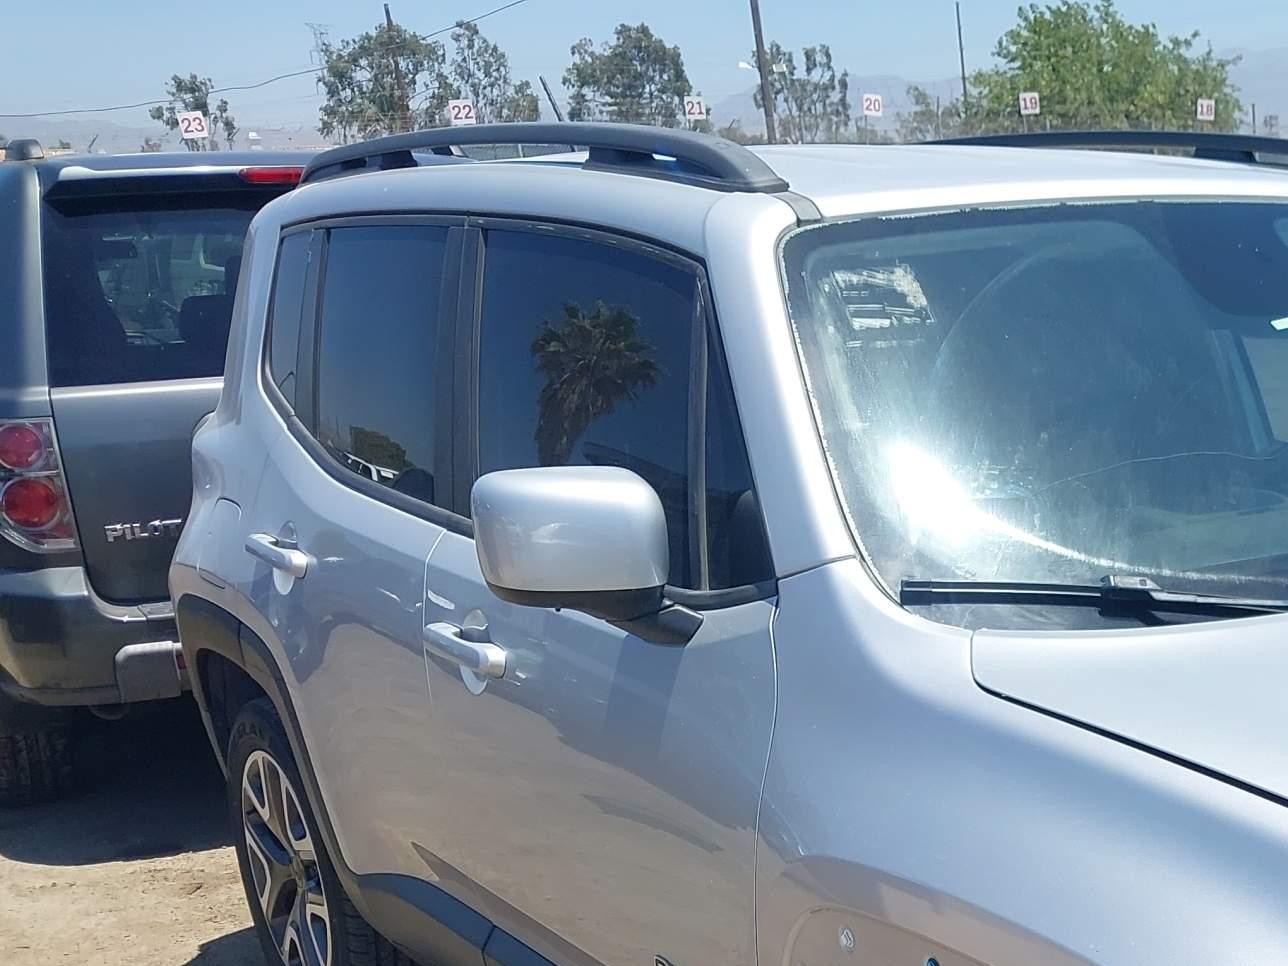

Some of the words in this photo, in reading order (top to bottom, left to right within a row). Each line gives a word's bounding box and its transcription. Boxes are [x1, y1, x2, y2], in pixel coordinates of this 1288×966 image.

[686, 100, 705, 115] 21
[864, 97, 881, 113] 20
[1021, 96, 1038, 110] 19
[1199, 103, 1213, 117] 18
[452, 104, 474, 120] 22
[180, 116, 205, 134] 23
[103, 519, 182, 542] PILOT
